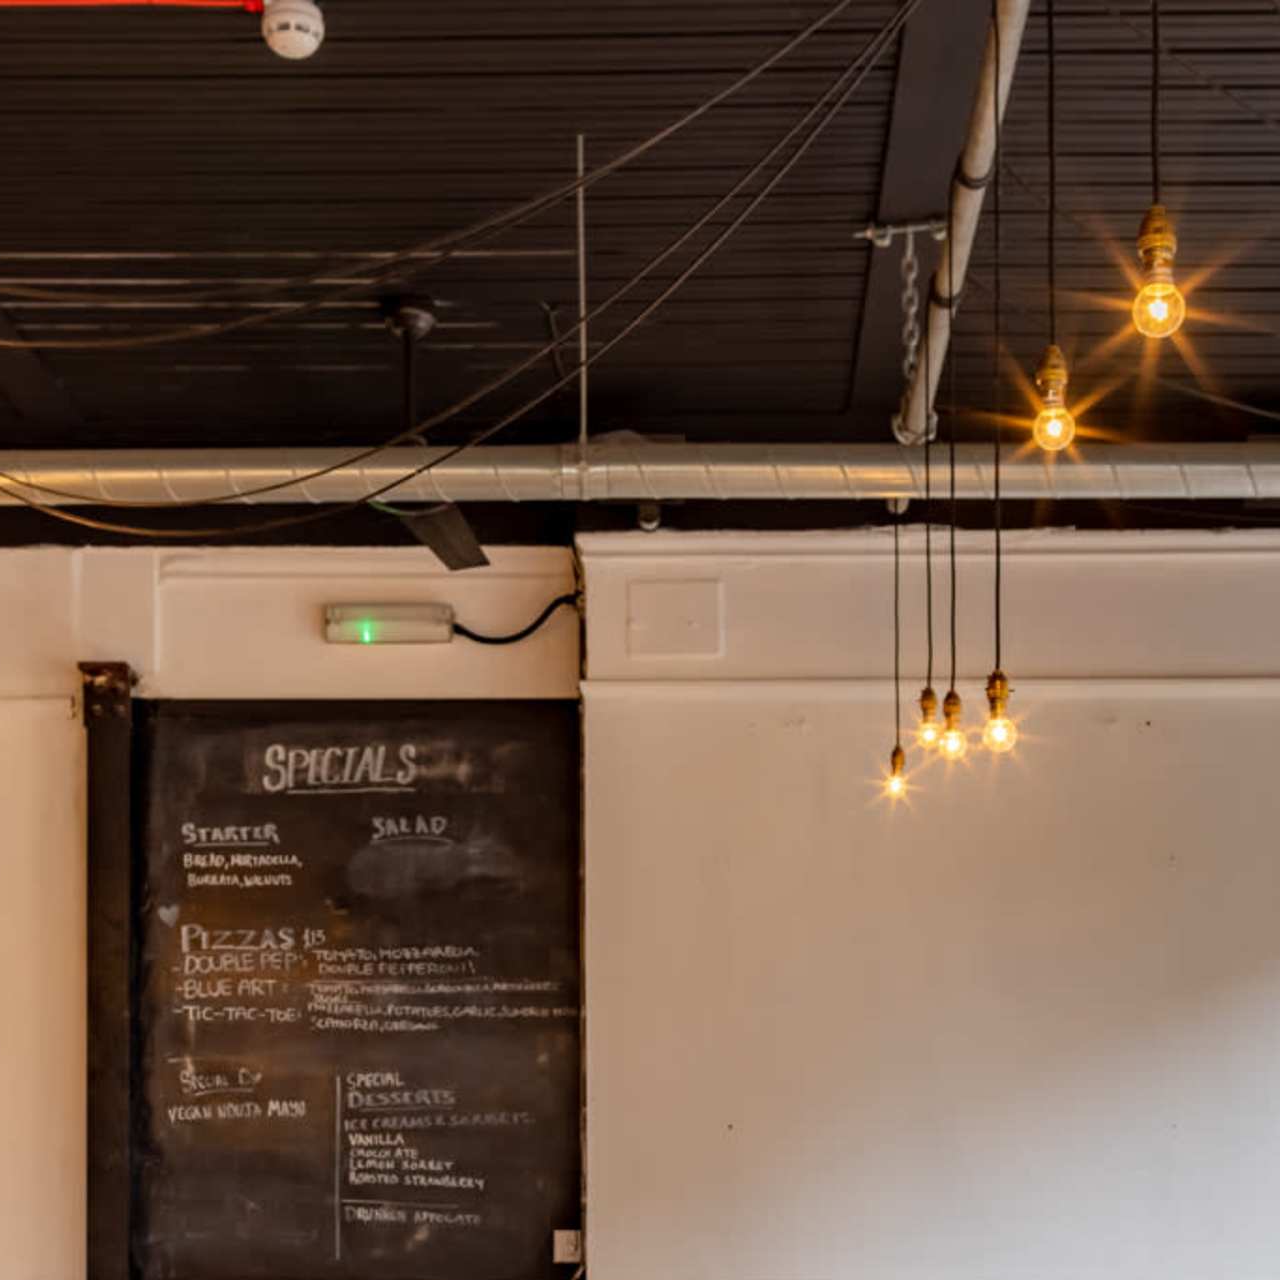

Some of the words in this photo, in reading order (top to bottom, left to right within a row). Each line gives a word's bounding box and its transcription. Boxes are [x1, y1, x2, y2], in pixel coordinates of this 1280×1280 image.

[263, 743, 417, 793] SPECIALS
[181, 823, 280, 845] STARTER
[372, 815, 448, 838] SALAD
[181, 924, 295, 951] PIZZAS
[346, 1071, 405, 1089] SPECIAL
[349, 1133, 405, 1146] VANILLA
